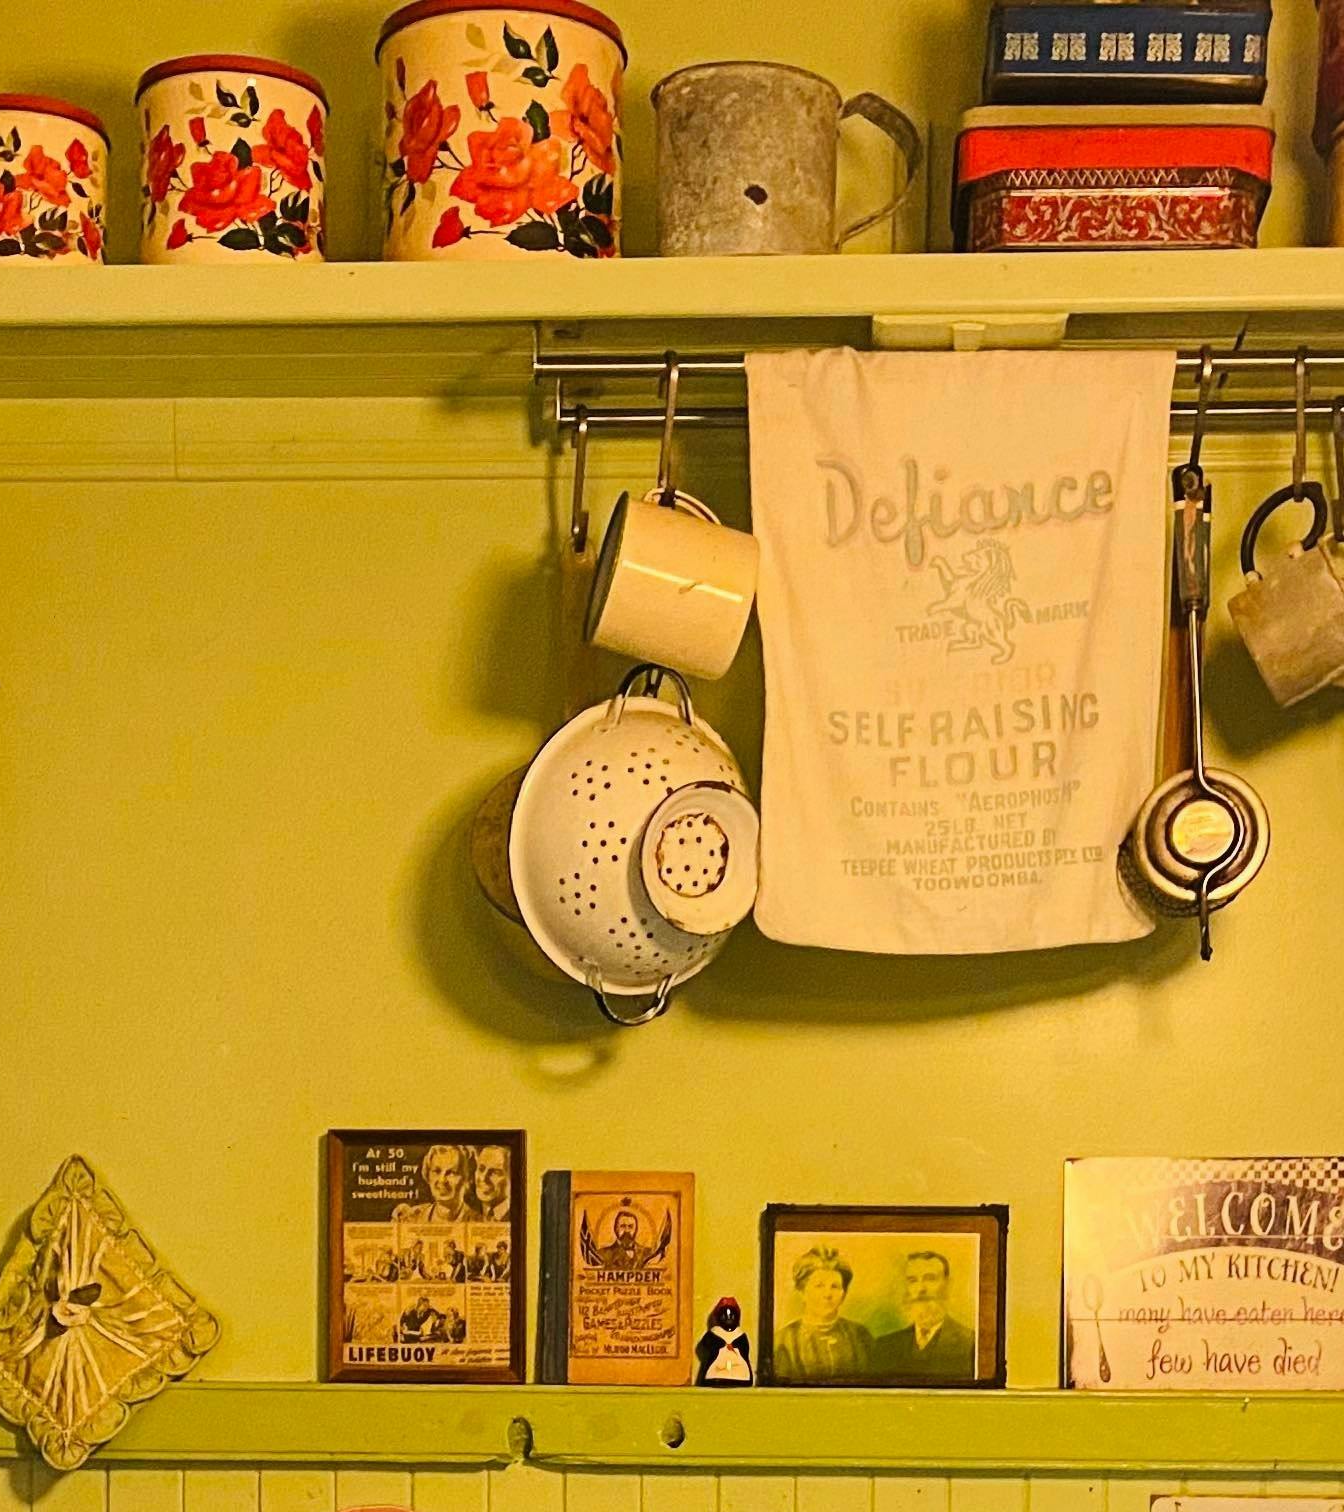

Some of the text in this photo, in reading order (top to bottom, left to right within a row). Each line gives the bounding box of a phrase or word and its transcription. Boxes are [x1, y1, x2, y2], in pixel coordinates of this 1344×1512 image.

[815, 454, 1114, 567] Defiance
[895, 601, 1090, 644] TRADE MARK
[827, 691, 1100, 749] SELF RAISING
[889, 740, 1057, 789] FLOUR
[993, 811, 1027, 832] NET
[886, 830, 1036, 856] MANUFACTURED
[903, 857, 957, 876] WHEAT
[965, 851, 1051, 873] PRODUCTS
[358, 1174, 414, 1187] husband's
[375, 1161, 396, 1173] still
[401, 1164, 419, 1175] my
[351, 1188, 420, 1200] sweetheart!
[596, 1271, 661, 1283] HAMPDEN
[1139, 1252, 1340, 1293] TO MY KITCHEN!
[1118, 1304, 1172, 1333] many
[1180, 1297, 1227, 1325] have
[1234, 1300, 1294, 1325] eaten
[348, 1346, 436, 1363] LIFEBUOY
[1146, 1336, 1323, 1381] few have died
